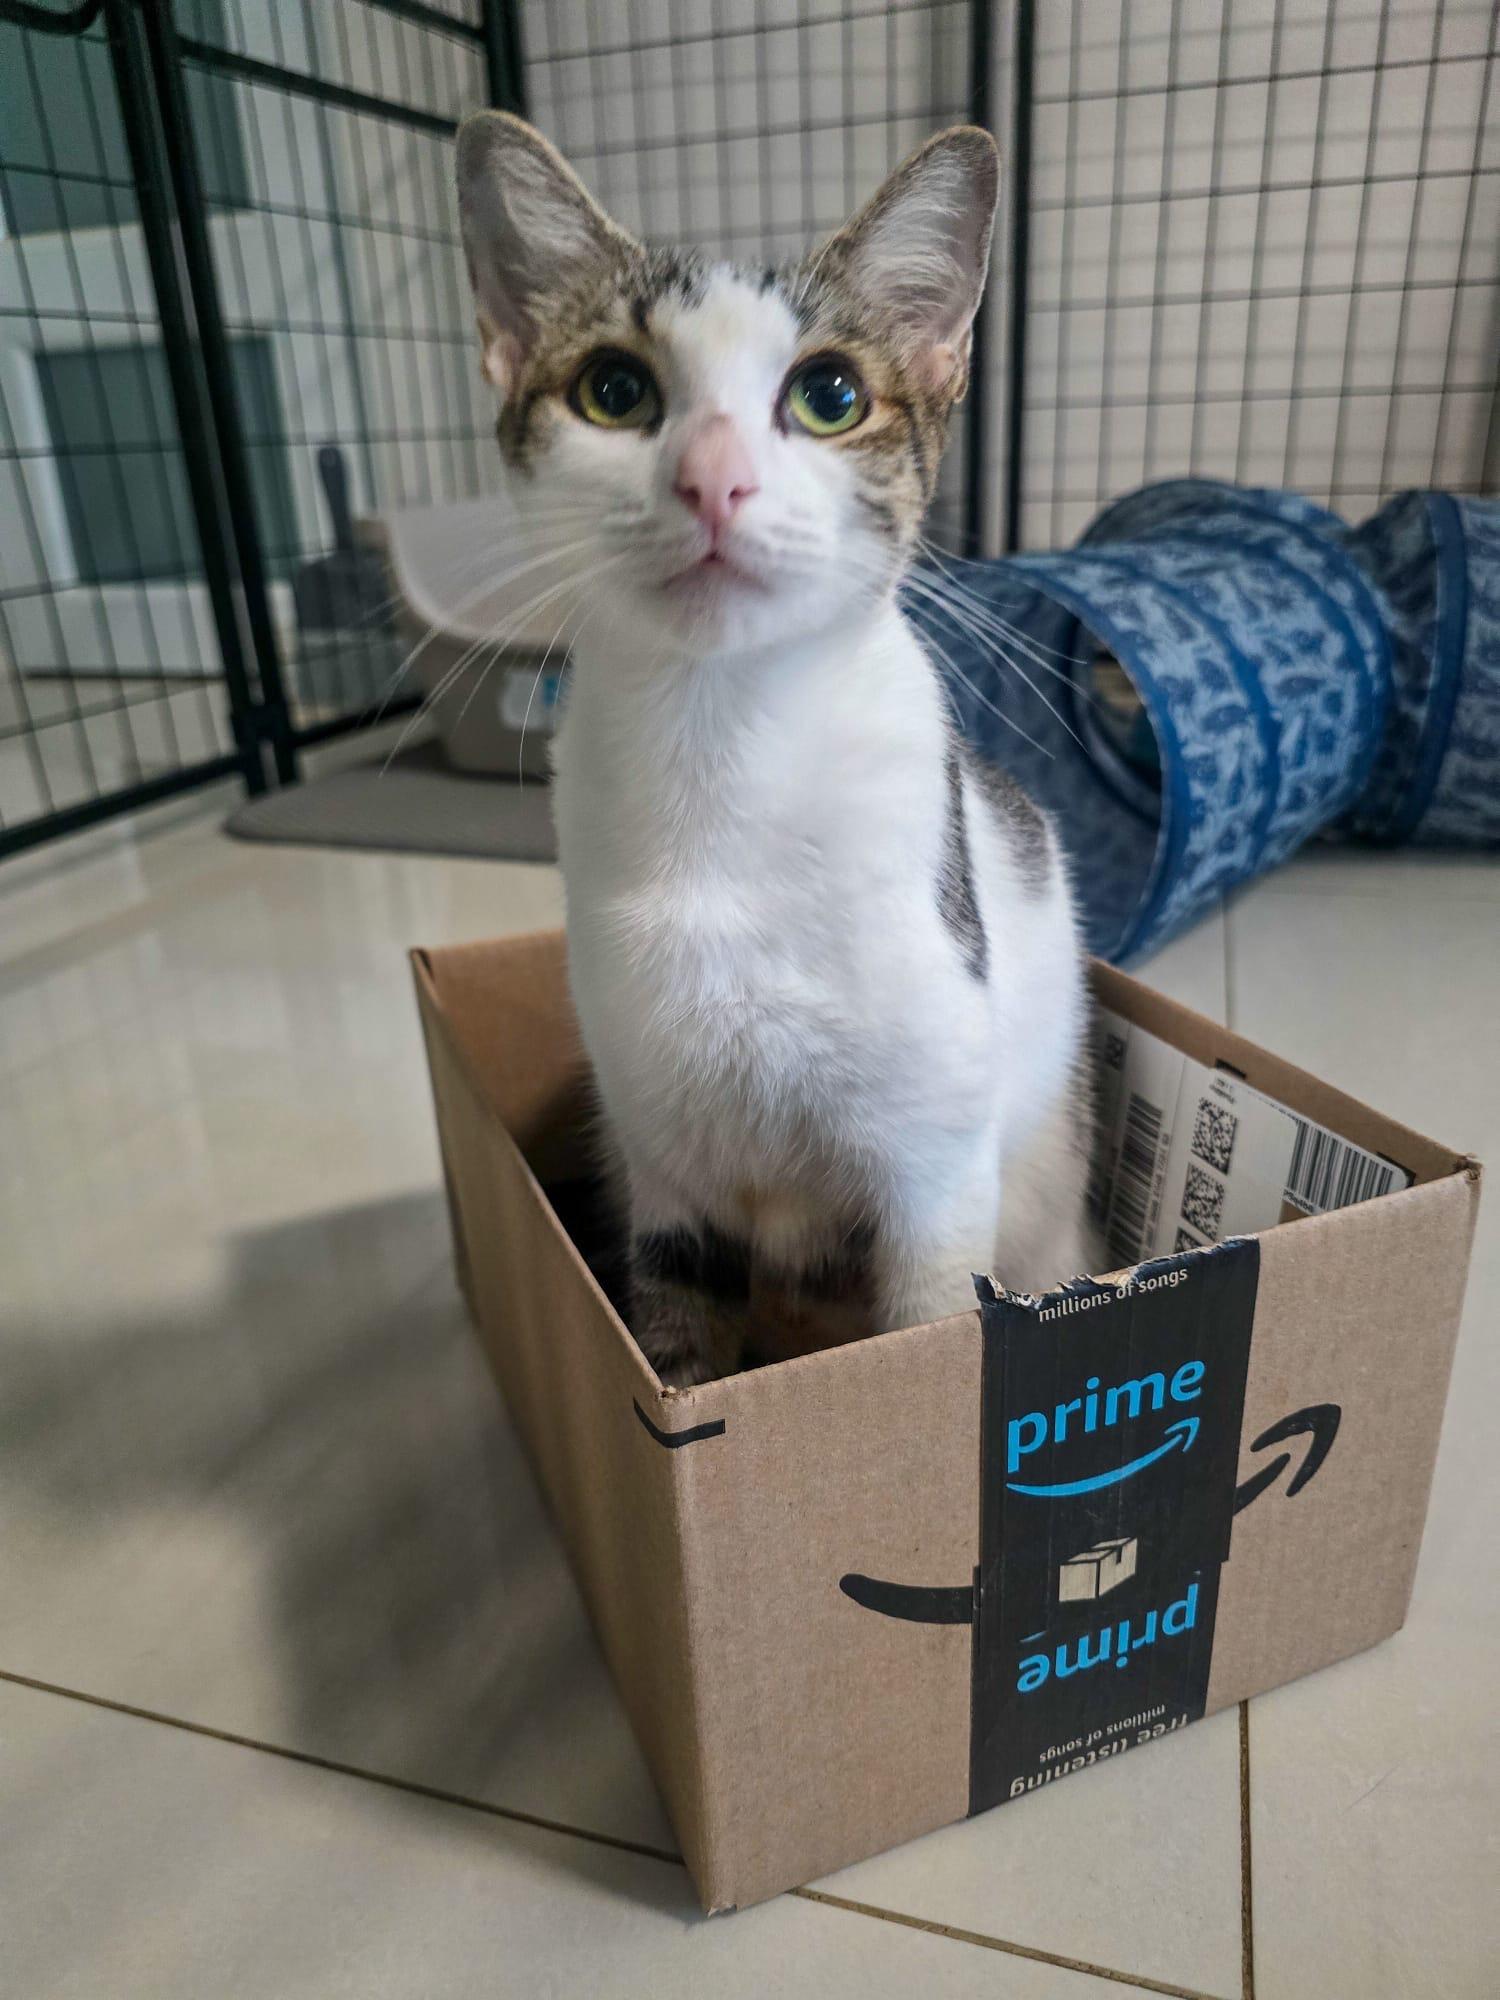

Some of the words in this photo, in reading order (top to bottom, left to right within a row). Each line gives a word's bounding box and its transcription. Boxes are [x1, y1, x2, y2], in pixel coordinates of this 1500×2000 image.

[1039, 1292, 1111, 1322] millions
[1116, 1283, 1133, 1301] of
[1138, 1268, 1189, 1294] songs
[1008, 1360, 1205, 1473] prime
[1017, 1583, 1199, 1692] prime
[1086, 1729, 1103, 1746] of
[1106, 1703, 1166, 1735] millions
[1039, 1737, 1083, 1763] songs
